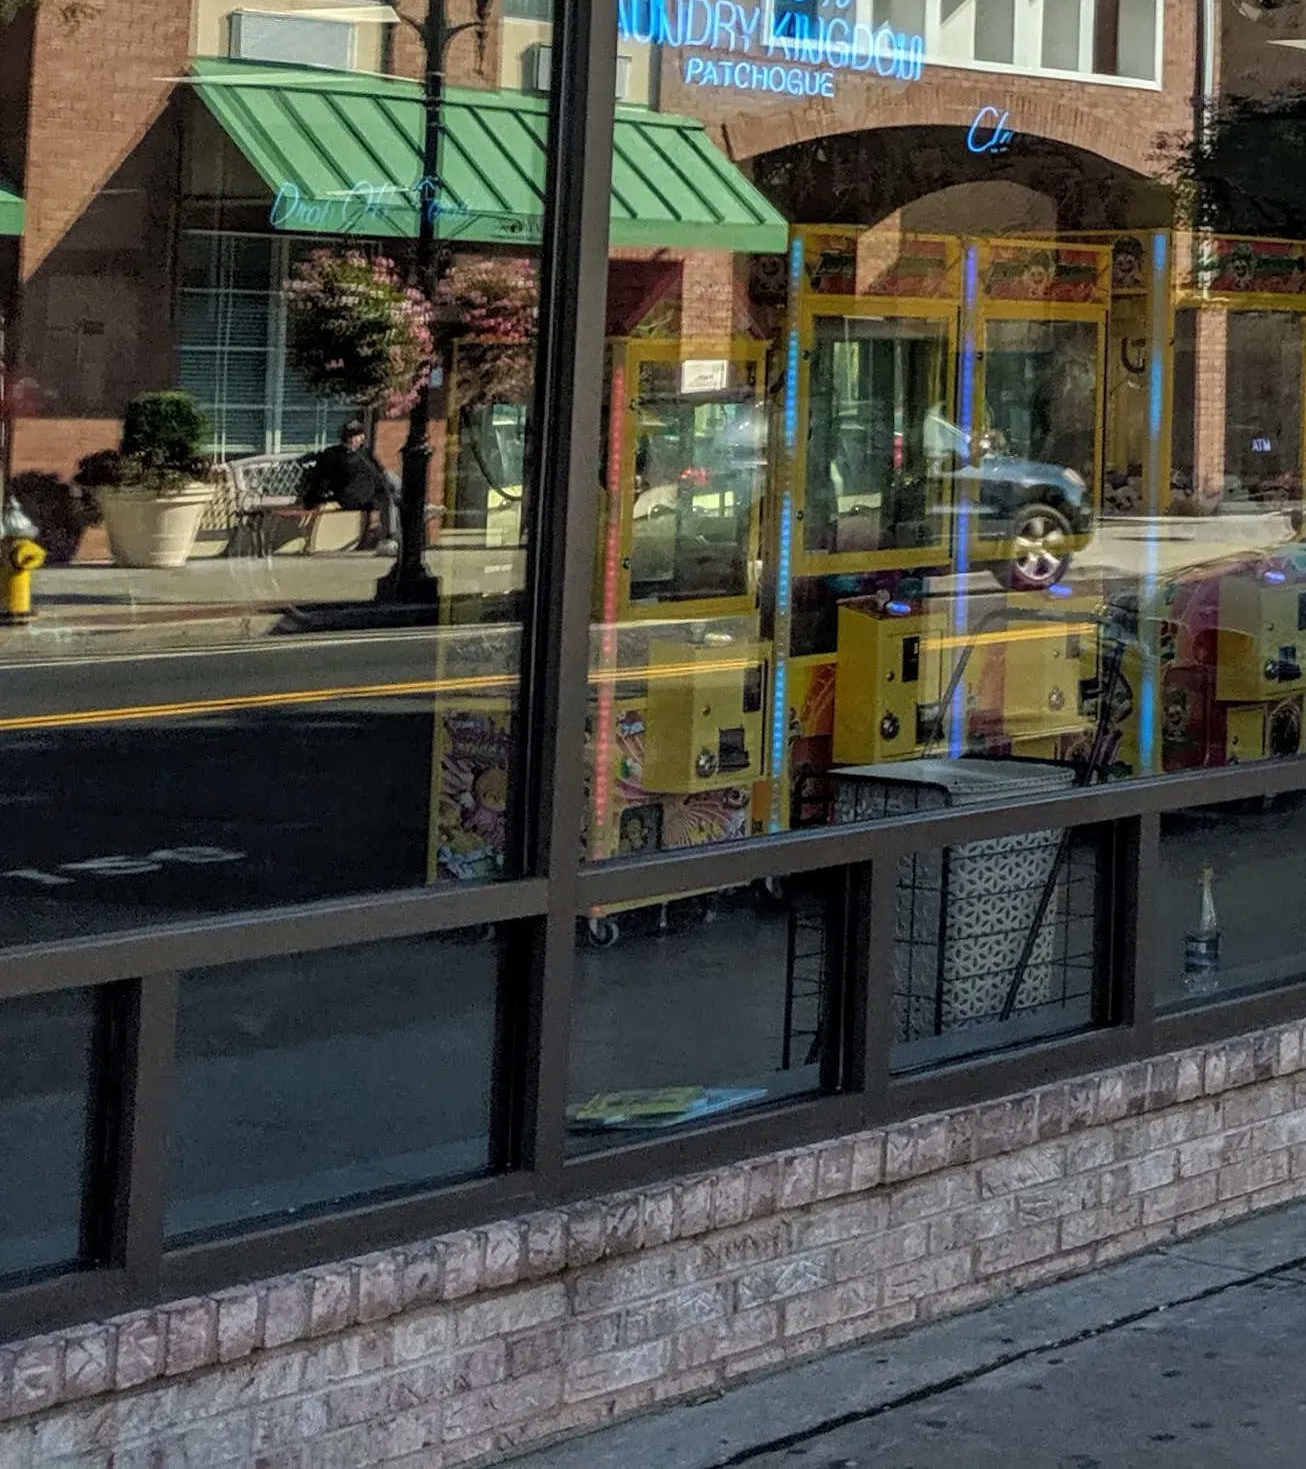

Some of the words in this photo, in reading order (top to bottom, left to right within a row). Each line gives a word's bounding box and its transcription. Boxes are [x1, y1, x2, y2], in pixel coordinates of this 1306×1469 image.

[767, 10, 924, 81] KINGDOM
[684, 57, 835, 98] PATCHOGUE
[1251, 438, 1272, 452] ATM
